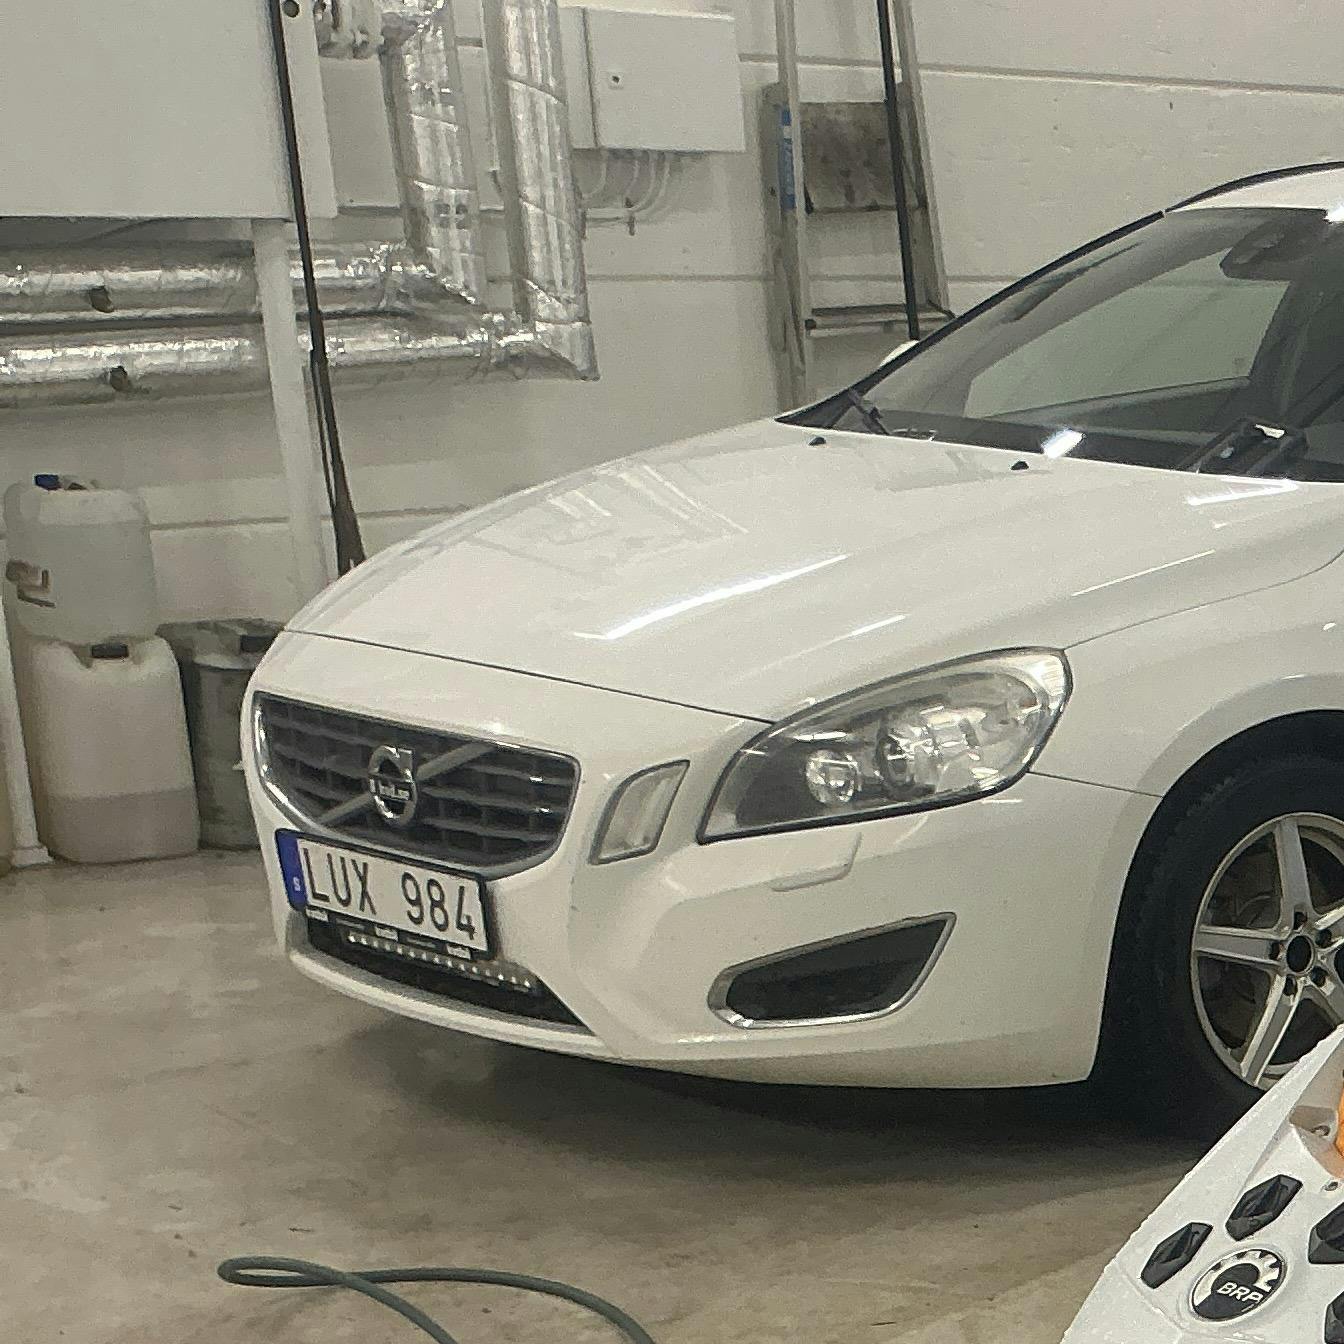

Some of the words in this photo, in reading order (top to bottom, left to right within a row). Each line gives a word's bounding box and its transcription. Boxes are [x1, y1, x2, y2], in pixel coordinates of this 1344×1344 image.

[293, 876, 302, 892] S
[303, 847, 377, 916] LUX
[401, 870, 478, 941] 984
[1215, 1280, 1264, 1304] BRP
